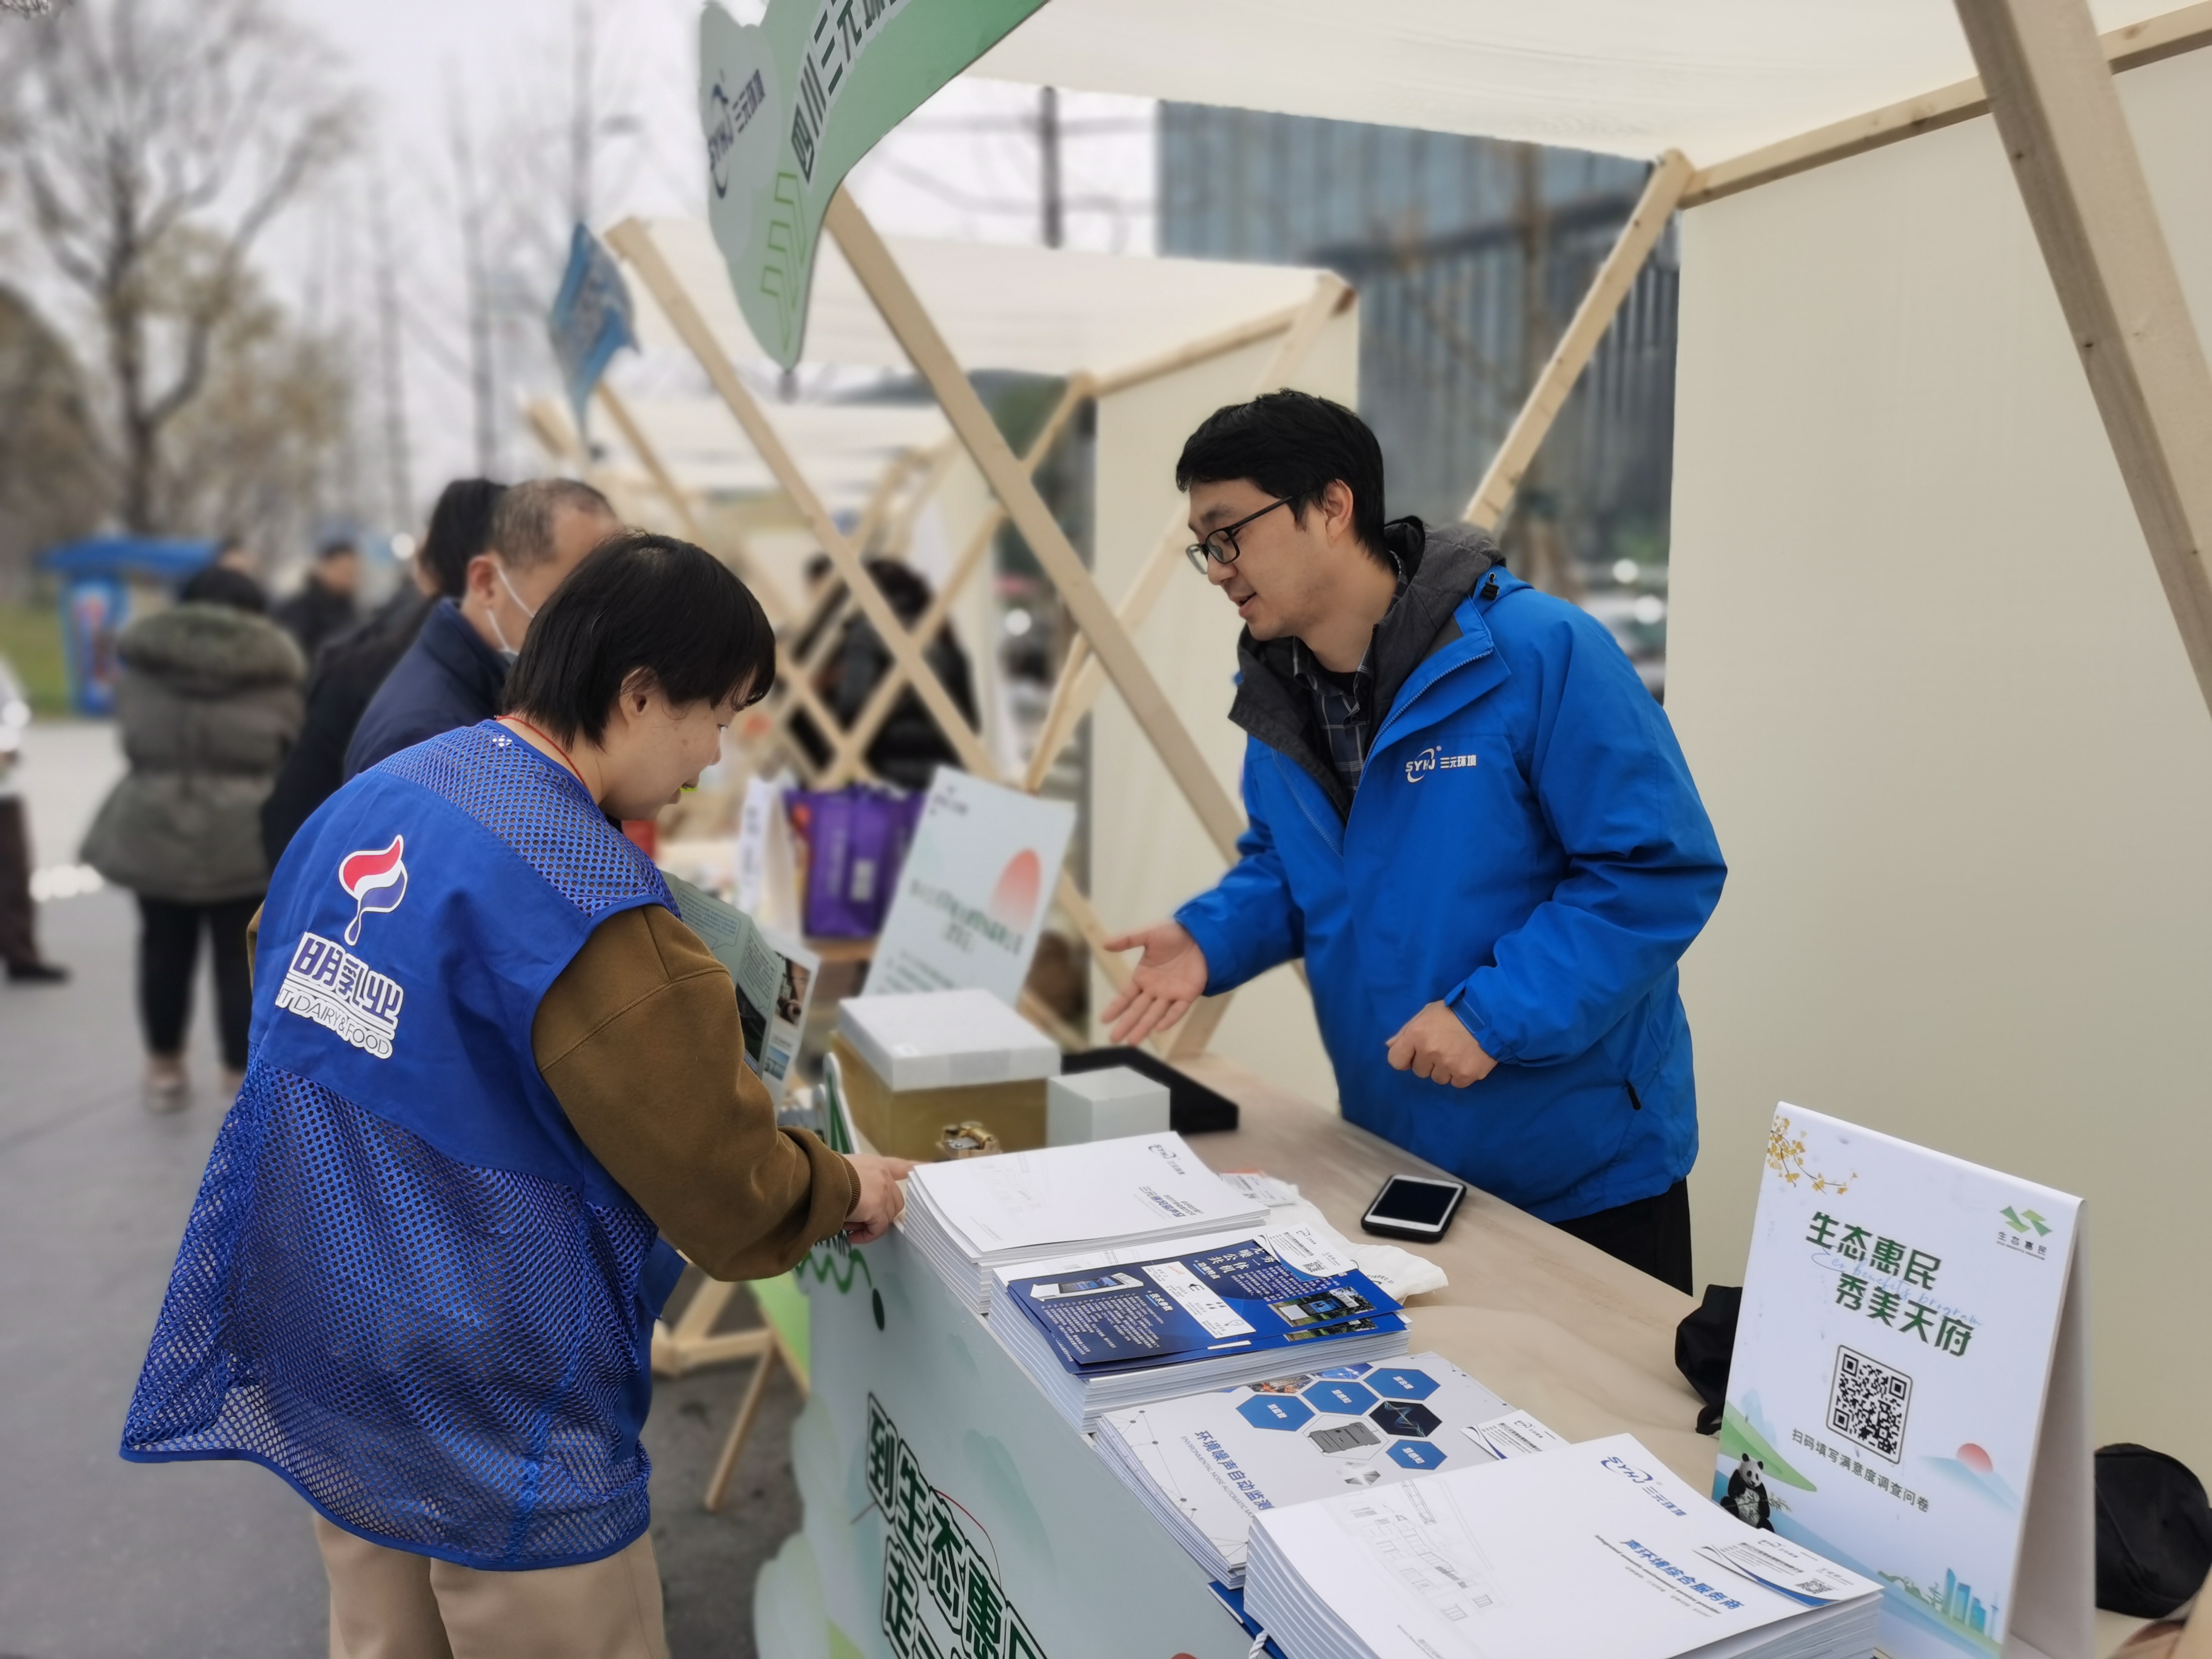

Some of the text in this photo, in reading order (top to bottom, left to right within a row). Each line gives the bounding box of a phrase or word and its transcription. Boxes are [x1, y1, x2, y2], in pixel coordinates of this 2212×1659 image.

[791, 0, 896, 184] 四川三元
[1805, 1212, 1942, 1291] 生态惠民
[1997, 1231, 2047, 1256] 生态惠民
[1835, 1272, 1975, 1358] 秀美天府
[1194, 1430, 1276, 1510] 环境噪声自动监测
[1607, 1456, 1646, 1484] SYHJ
[1792, 1428, 1930, 1513] 扫码填写满意度调查问卷
[868, 1393, 1048, 1659] 到生态惠
[1620, 1538, 1745, 1610] 声环境综合服务商
